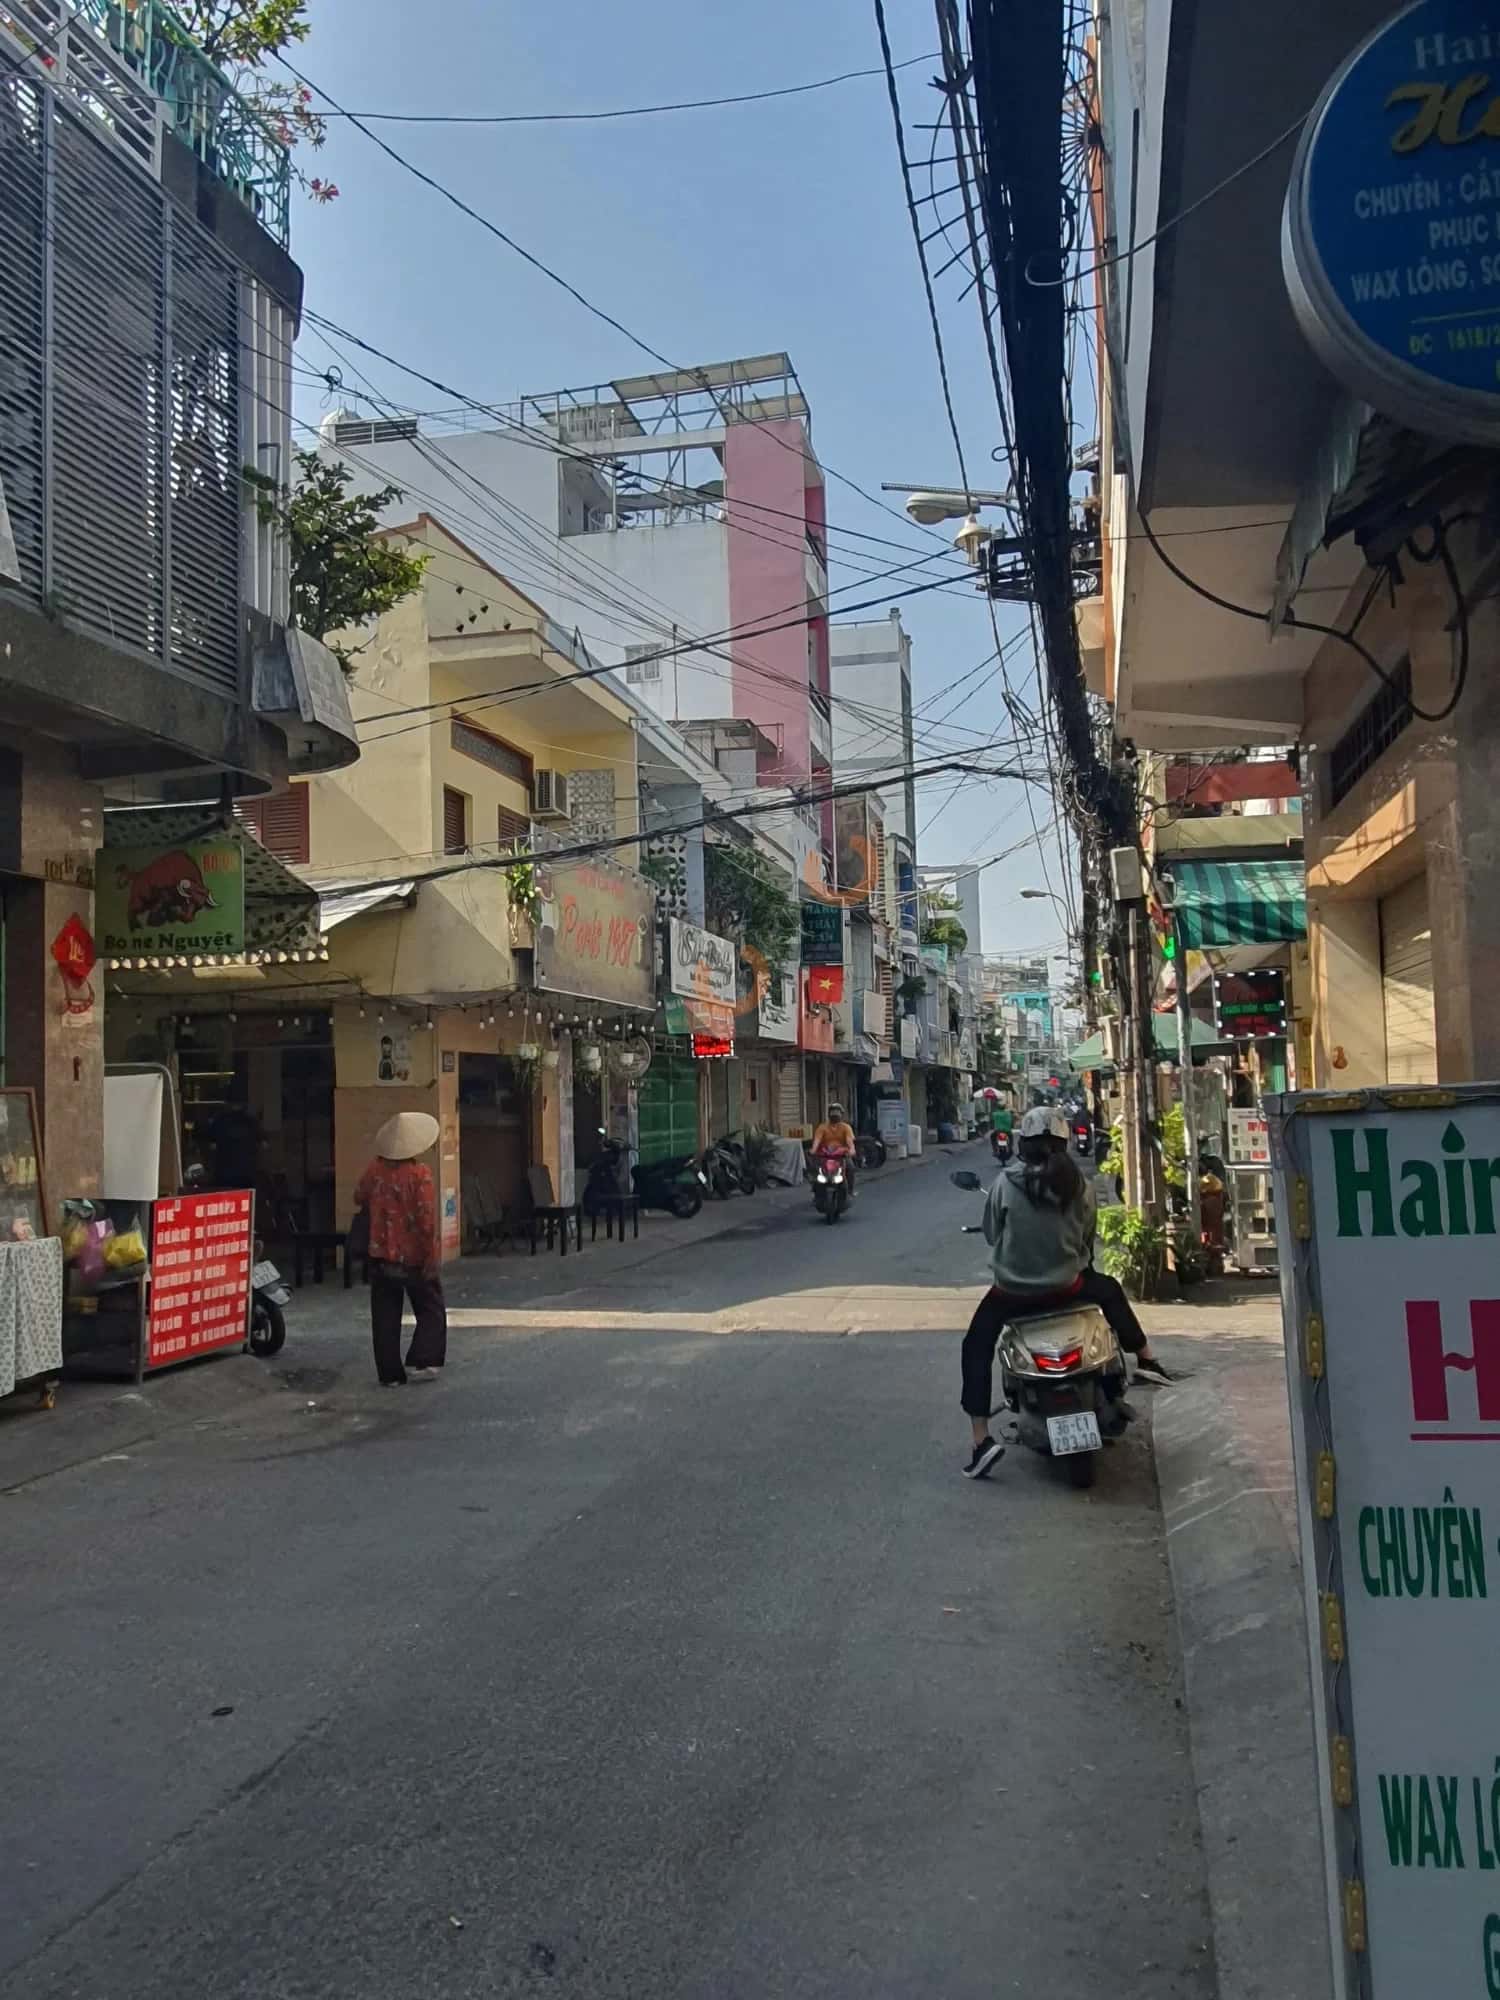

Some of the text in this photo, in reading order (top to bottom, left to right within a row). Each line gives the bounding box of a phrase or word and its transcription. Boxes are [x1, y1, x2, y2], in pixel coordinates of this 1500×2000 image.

[1414, 24, 1500, 70] Hai
[1351, 266, 1400, 303] WAX
[1358, 1486, 1487, 1599] CHUYÊN
[1379, 1774, 1466, 1869] WAX
